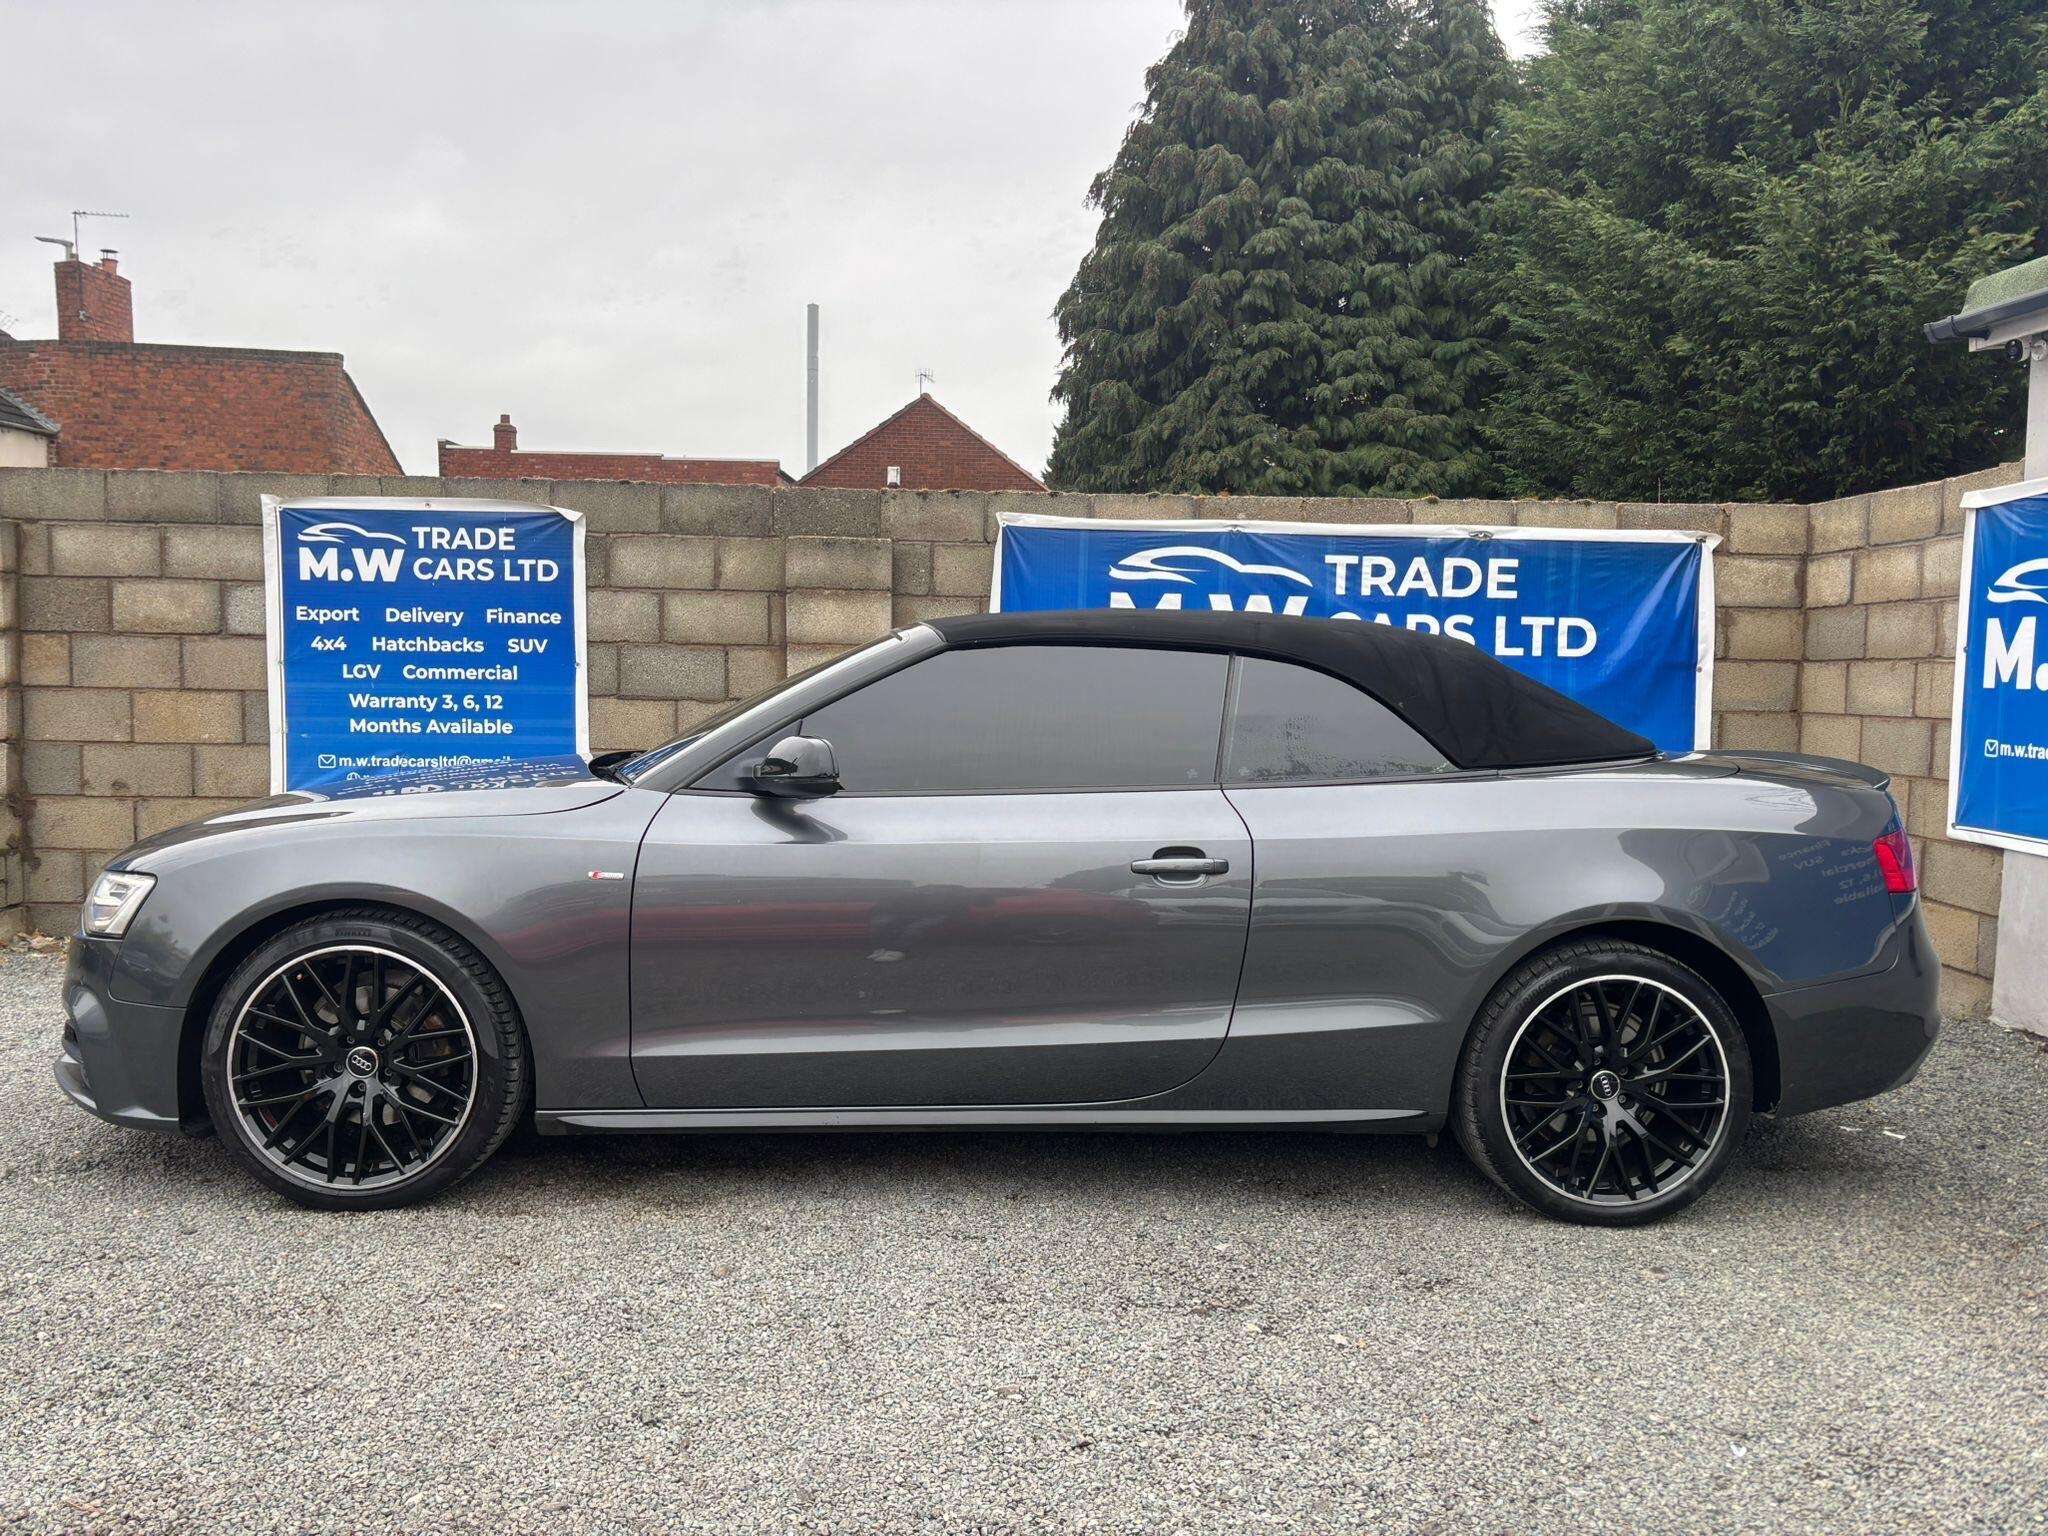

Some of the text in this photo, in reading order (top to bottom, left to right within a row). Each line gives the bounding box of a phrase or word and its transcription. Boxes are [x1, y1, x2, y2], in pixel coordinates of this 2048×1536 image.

[412, 526, 516, 551] TRADE
[298, 547, 405, 583] M.W
[412, 557, 559, 583] CARS LTD
[1325, 554, 1519, 599] TRADE
[295, 605, 562, 626] Export Delivery Finance
[310, 636, 548, 654] 4x4 Hatchbacks SUV
[1494, 615, 1597, 658] LTD
[342, 664, 518, 681] LGV Commercial
[348, 693, 503, 712] Warranty 3, 6, 12
[349, 718, 514, 734] Months Available
